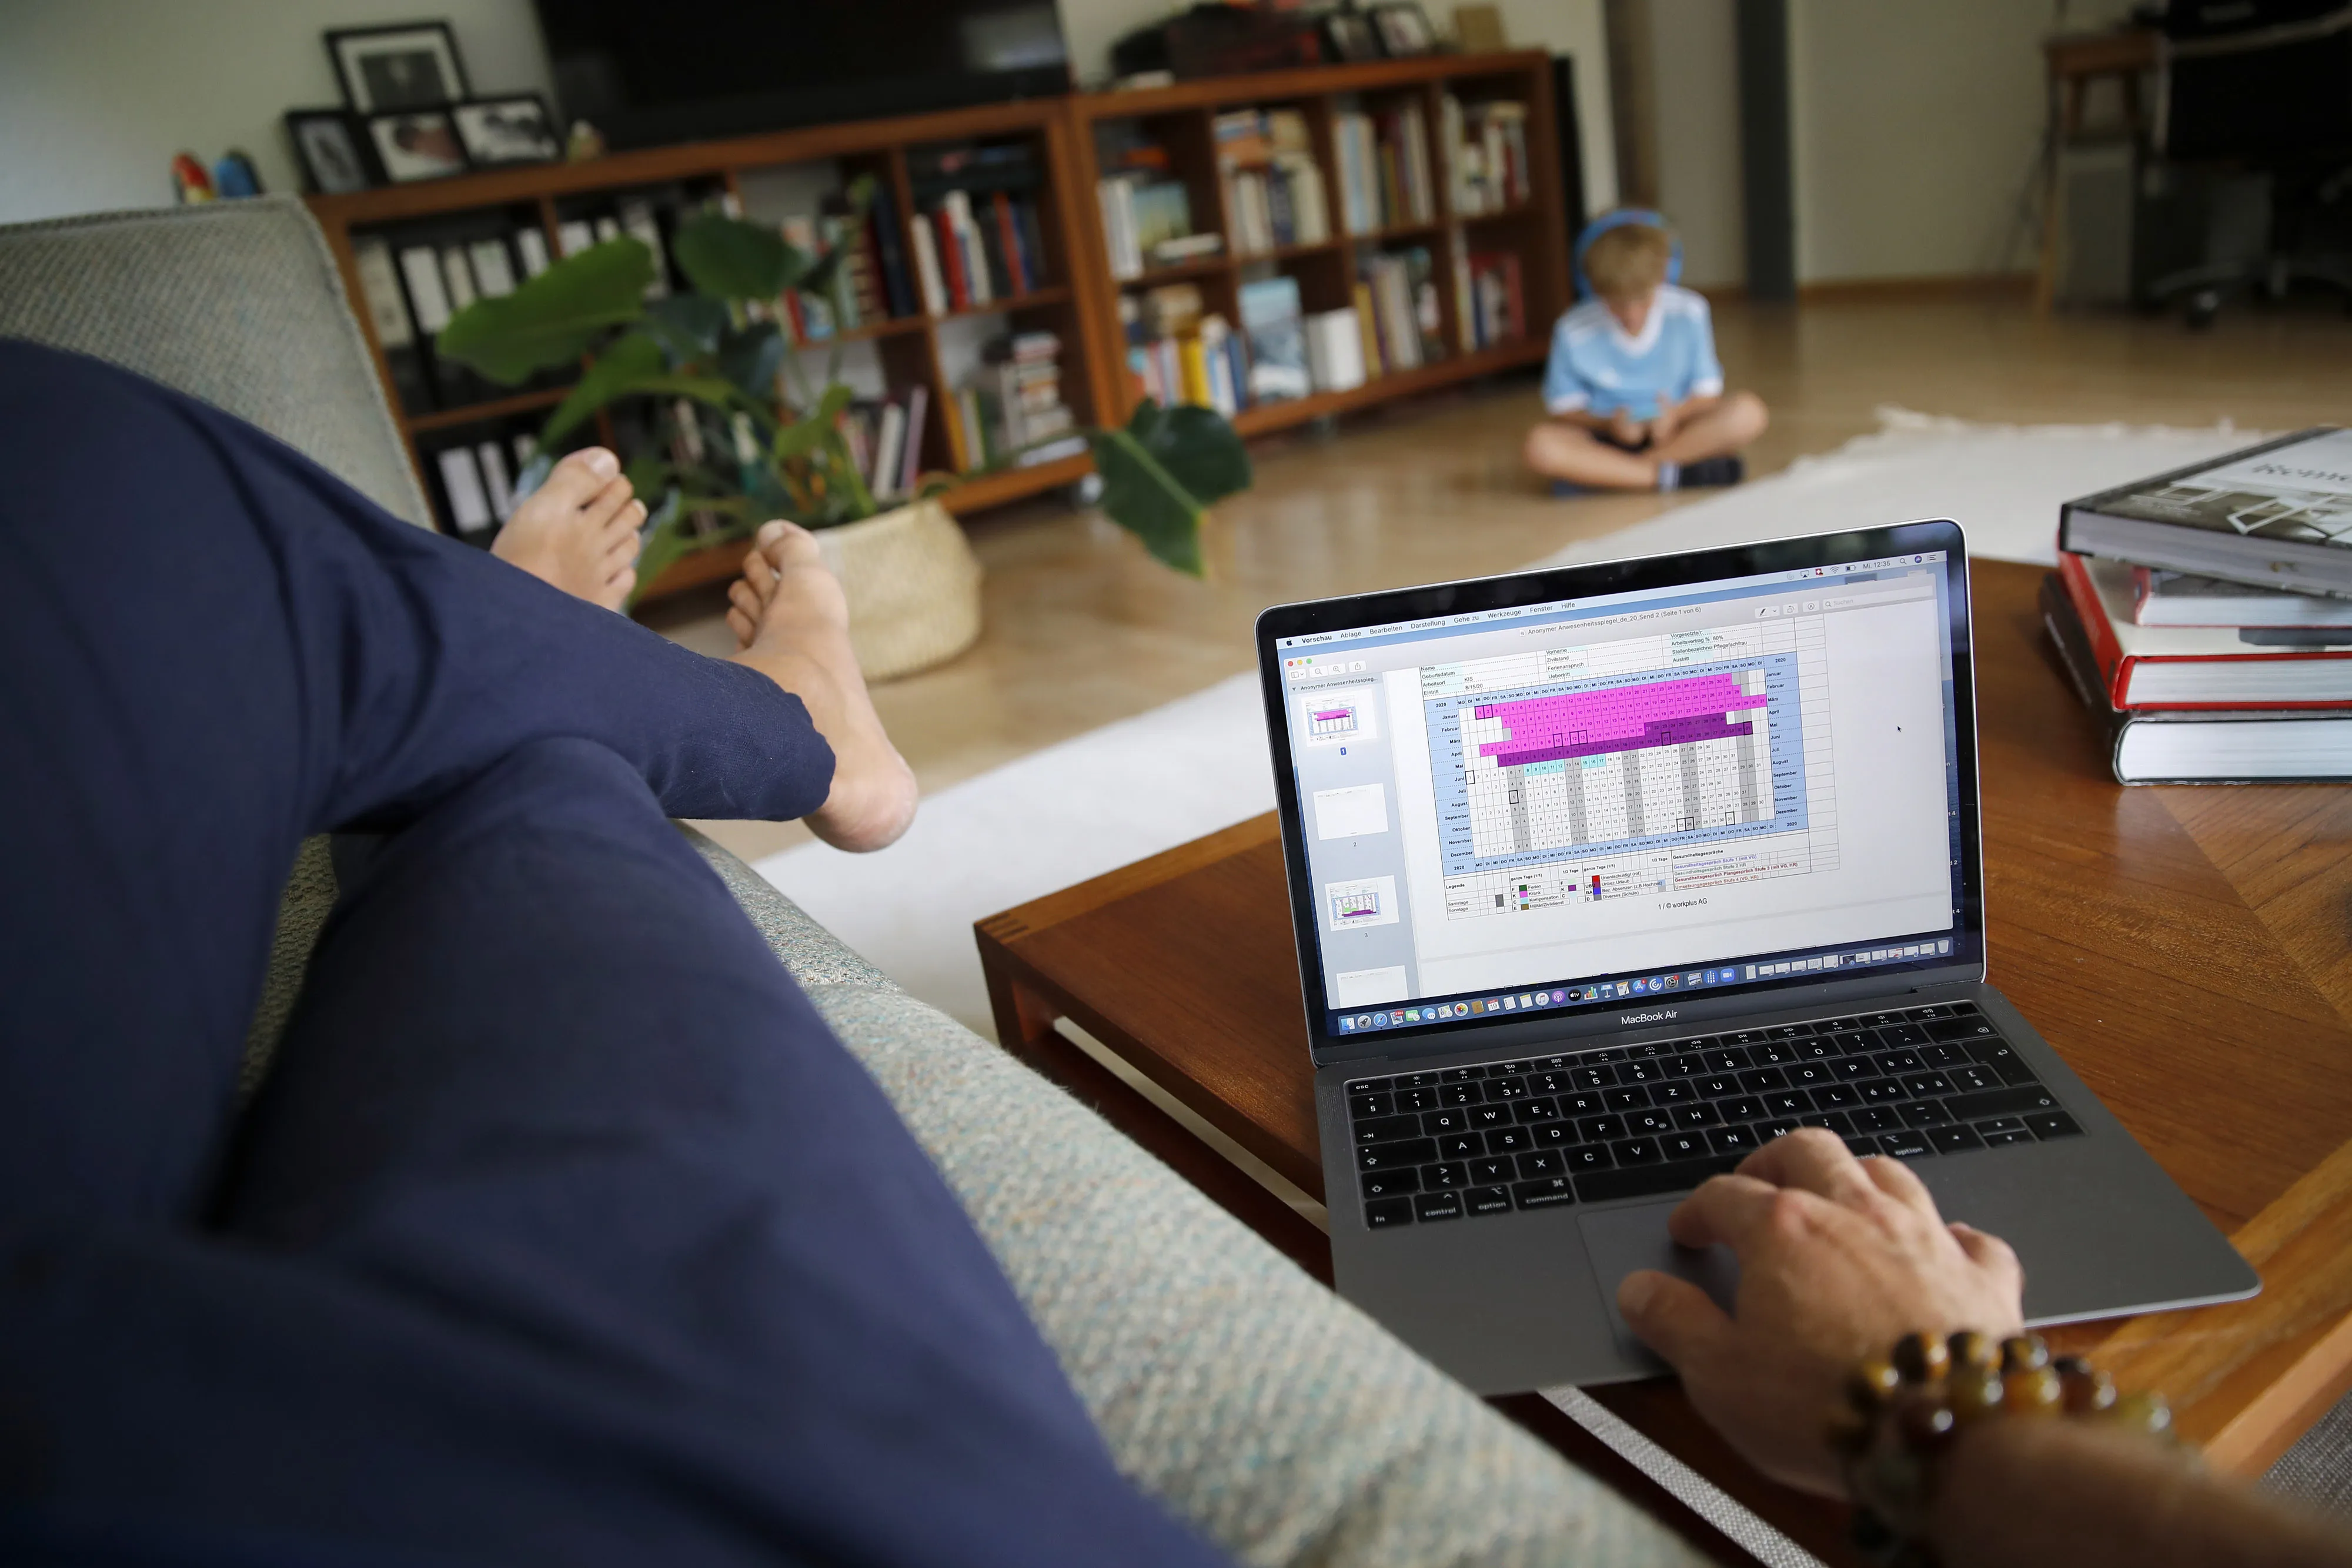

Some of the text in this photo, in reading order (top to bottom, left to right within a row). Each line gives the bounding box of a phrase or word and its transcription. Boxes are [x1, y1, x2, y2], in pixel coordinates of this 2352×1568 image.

[1488, 609, 1522, 618] Werkzeuge
[1411, 619, 1445, 629] Darstellung
[1528, 626, 1556, 635] Anonymer
[1661, 610, 1677, 618] (Seite
[1341, 630, 1361, 638] Ablage
[1369, 626, 1402, 634] Bearbeiten
[1302, 634, 1332, 643] Vorschau
[1671, 638, 1704, 646] Arbeitsvertrag
[1672, 640, 1747, 654] Stellenbezeichnu Pflegefachfrau
[1548, 662, 1584, 671] Ferienanspruch
[1673, 849, 1723, 860] Gesundheitsgespräche
[1673, 859, 1722, 870] Gesundheitsgespräch
[1601, 872, 1632, 880] Unentschuldigt
[1675, 872, 1723, 882] Gesundheitsgespräch
[1723, 868, 1753, 877] Plangespräch
[1529, 894, 1559, 902] Kompensation
[1672, 900, 1698, 908] workplus
[1621, 1009, 1678, 1025] MacBook Air
[1740, 1105, 1748, 1114] J
[1690, 1111, 1702, 1120] H
[1645, 1118, 1654, 1126] G
[1775, 1128, 1787, 1137] M
[1727, 1134, 1739, 1143] N
[1679, 1141, 1690, 1149] B
[1632, 1146, 1641, 1155] V
[1895, 1146, 1924, 1156] option
[1584, 1153, 1594, 1161] C
[1536, 1159, 1546, 1168] X
[1488, 1165, 1496, 1174] Y
[1526, 1193, 1568, 1204] command
[1478, 1200, 1506, 1211] option
[1425, 1207, 1456, 1216] control
